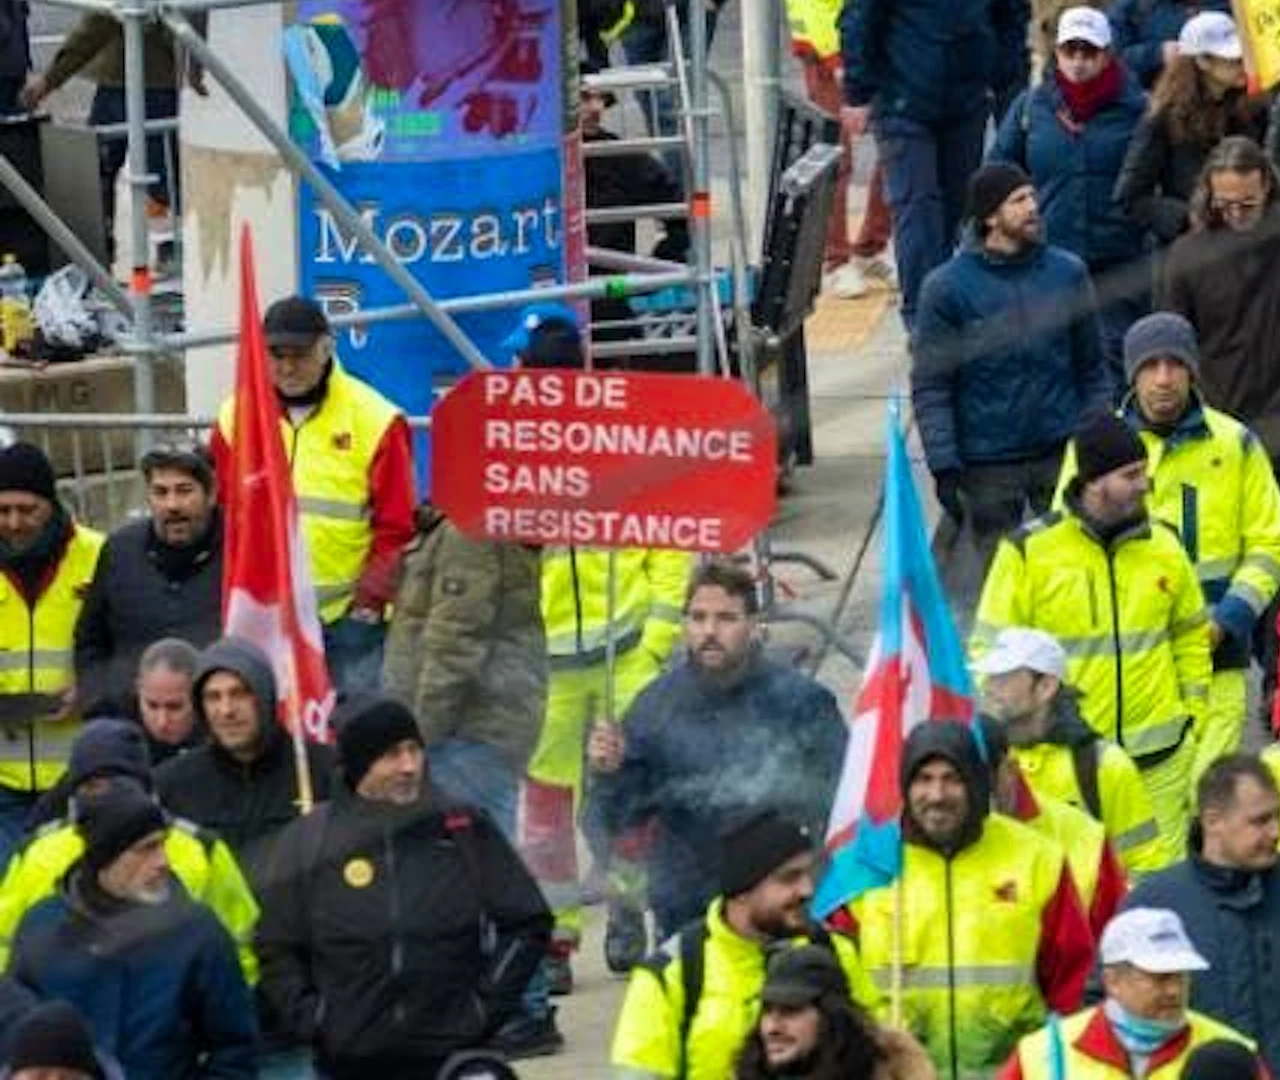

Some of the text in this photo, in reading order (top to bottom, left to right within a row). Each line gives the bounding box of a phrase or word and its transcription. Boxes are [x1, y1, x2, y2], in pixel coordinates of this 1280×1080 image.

[314, 197, 561, 264] Mozart
[485, 374, 628, 409] PAS DE
[485, 419, 753, 462] RESONNANCE
[485, 462, 590, 498] SANS
[485, 505, 722, 548] RESISTANCE
